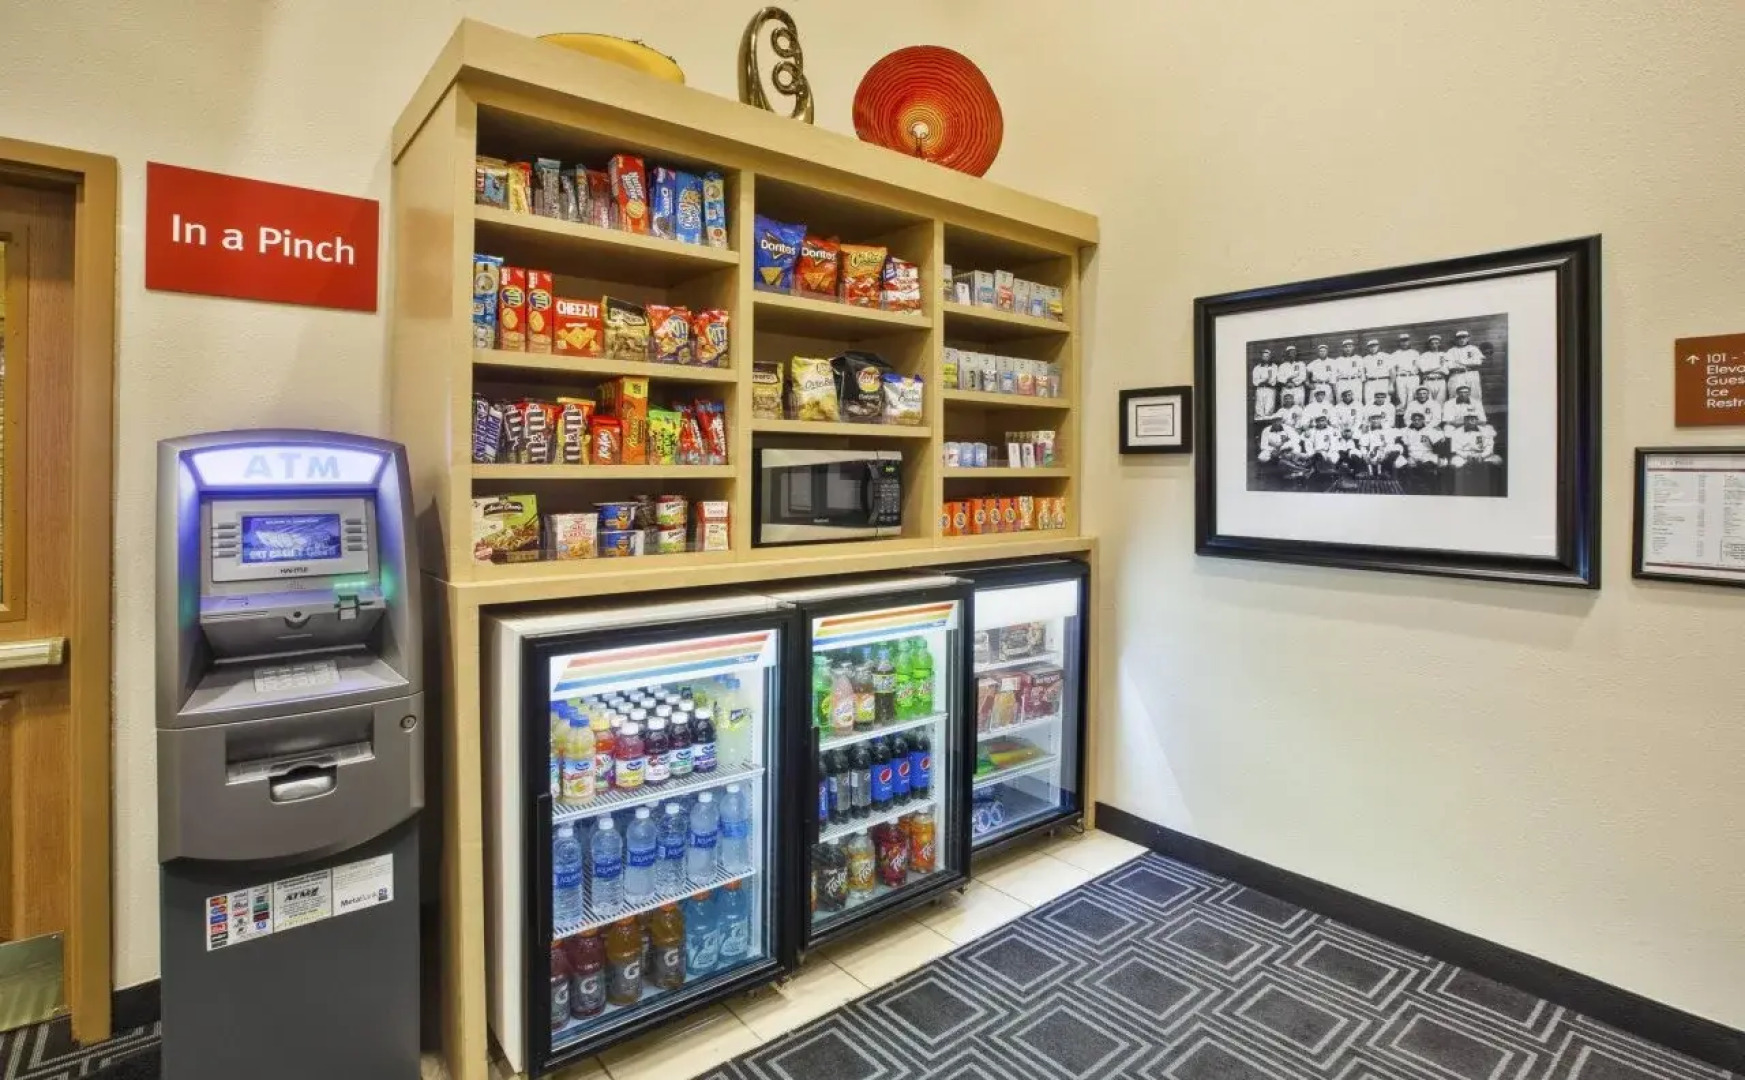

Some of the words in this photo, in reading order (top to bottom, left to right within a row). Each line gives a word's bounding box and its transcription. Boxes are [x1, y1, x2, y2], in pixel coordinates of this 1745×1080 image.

[172, 213, 207, 246] In
[221, 228, 244, 251] a
[258, 225, 355, 266] Pinch
[760, 239, 797, 256] Doritos
[555, 300, 599, 318] CHEEZ-IT
[1707, 353, 1727, 364] 101
[1706, 388, 1730, 398] Ice
[1707, 398, 1745, 409] Restr
[243, 452, 341, 481] ATM
[664, 949, 679, 967] G
[624, 961, 640, 979] G
[555, 983, 568, 1004] G
[580, 978, 598, 995] G
